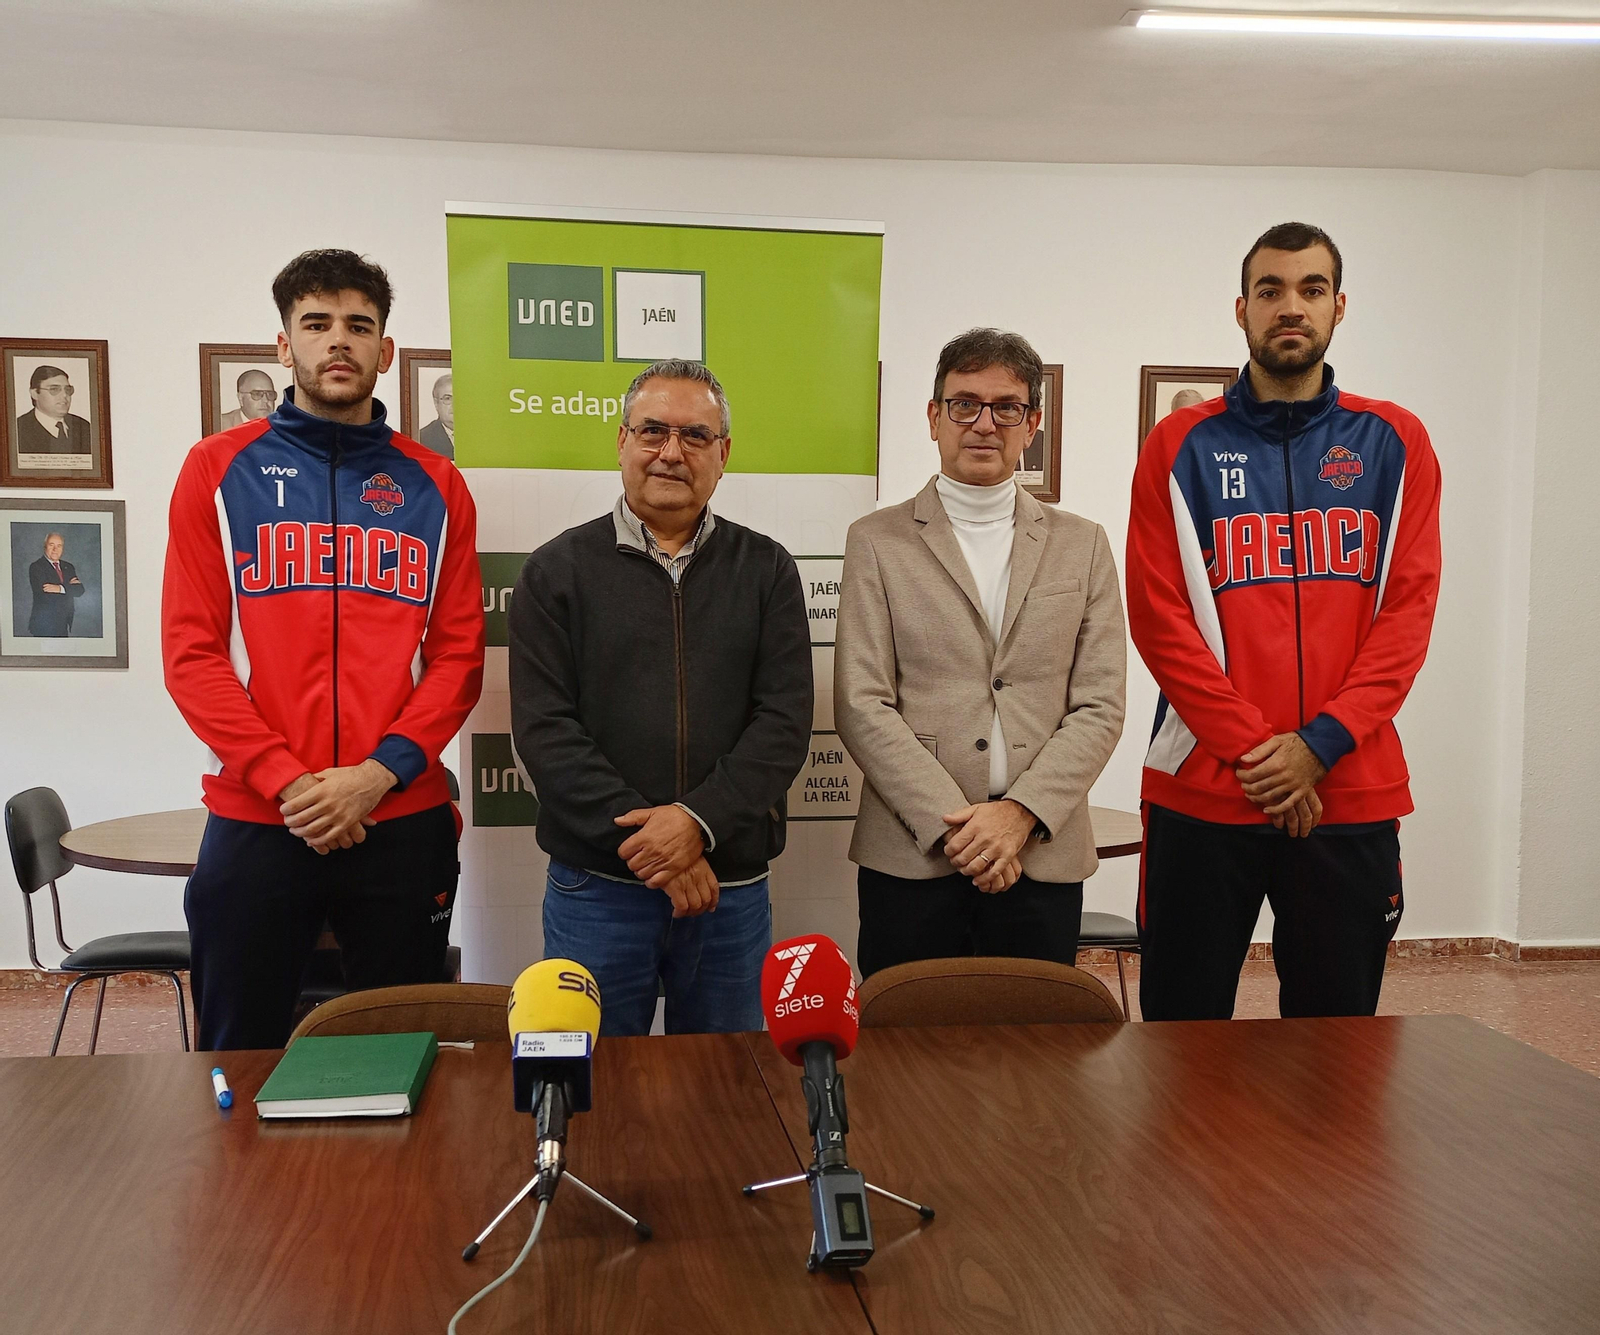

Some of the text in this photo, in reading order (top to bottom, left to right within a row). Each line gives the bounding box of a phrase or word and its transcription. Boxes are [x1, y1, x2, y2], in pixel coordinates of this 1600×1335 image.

[517, 298, 595, 327] UNED
[642, 307, 676, 325] JAÉN
[509, 388, 543, 414] Se
[1213, 451, 1249, 463] vive
[260, 464, 298, 478] vive
[274, 479, 285, 508] 1
[1219, 467, 1246, 500] 13
[1206, 507, 1381, 591] JAENCB
[241, 521, 429, 602] JAENCB
[809, 580, 842, 599] JAÉN
[806, 608, 840, 620] INAR
[810, 750, 843, 768] JAÉN
[805, 776, 849, 788] ALCALÁ
[804, 790, 852, 802] LA REAL
[774, 943, 817, 1001] 7
[774, 994, 825, 1018] siete
